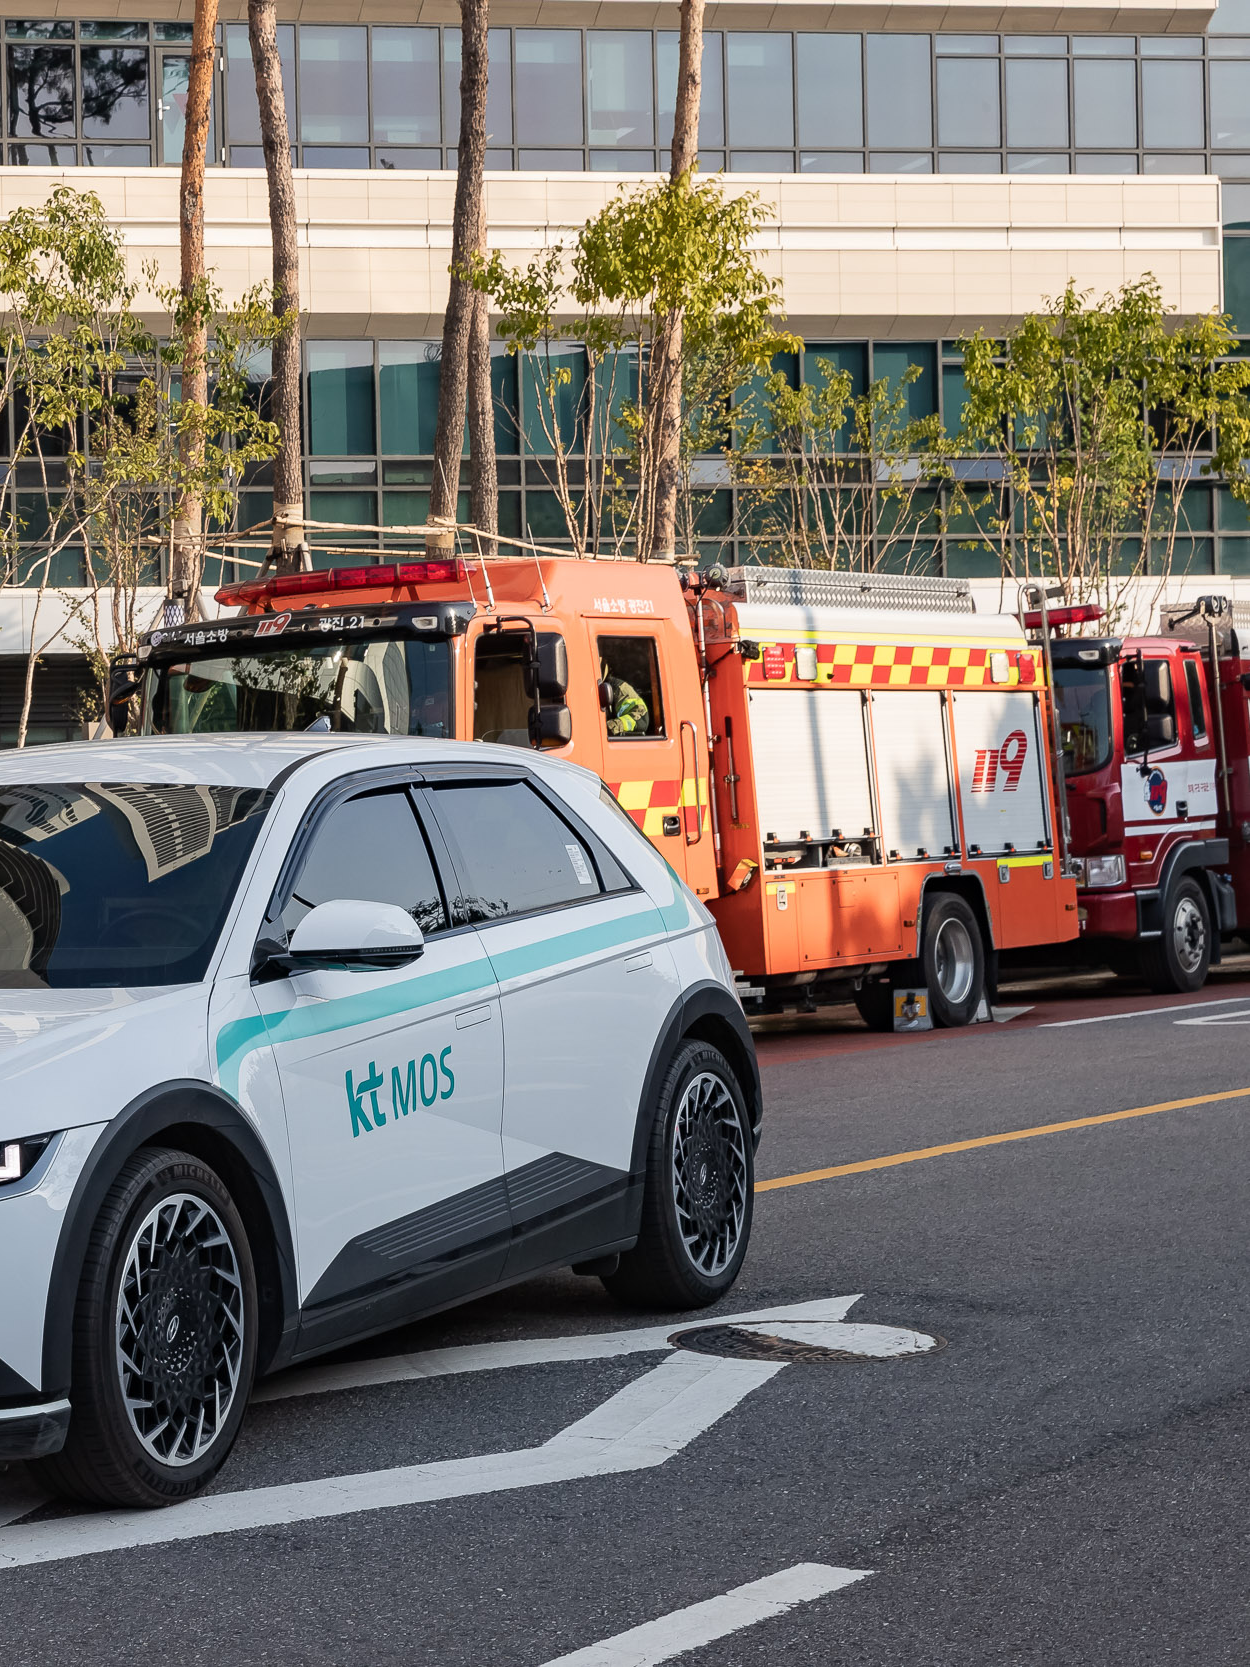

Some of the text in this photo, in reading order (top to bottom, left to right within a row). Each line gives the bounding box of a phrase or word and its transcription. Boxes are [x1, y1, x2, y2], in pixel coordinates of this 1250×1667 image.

[593, 598, 626, 614] 서울소방
[254, 613, 291, 637] 119
[318, 615, 365, 632] 광진 21
[184, 628, 230, 646] 서울소방
[971, 729, 1028, 792] 119
[345, 1045, 455, 1138] kt MOS
[173, 1165, 228, 1200] MICHELIN
